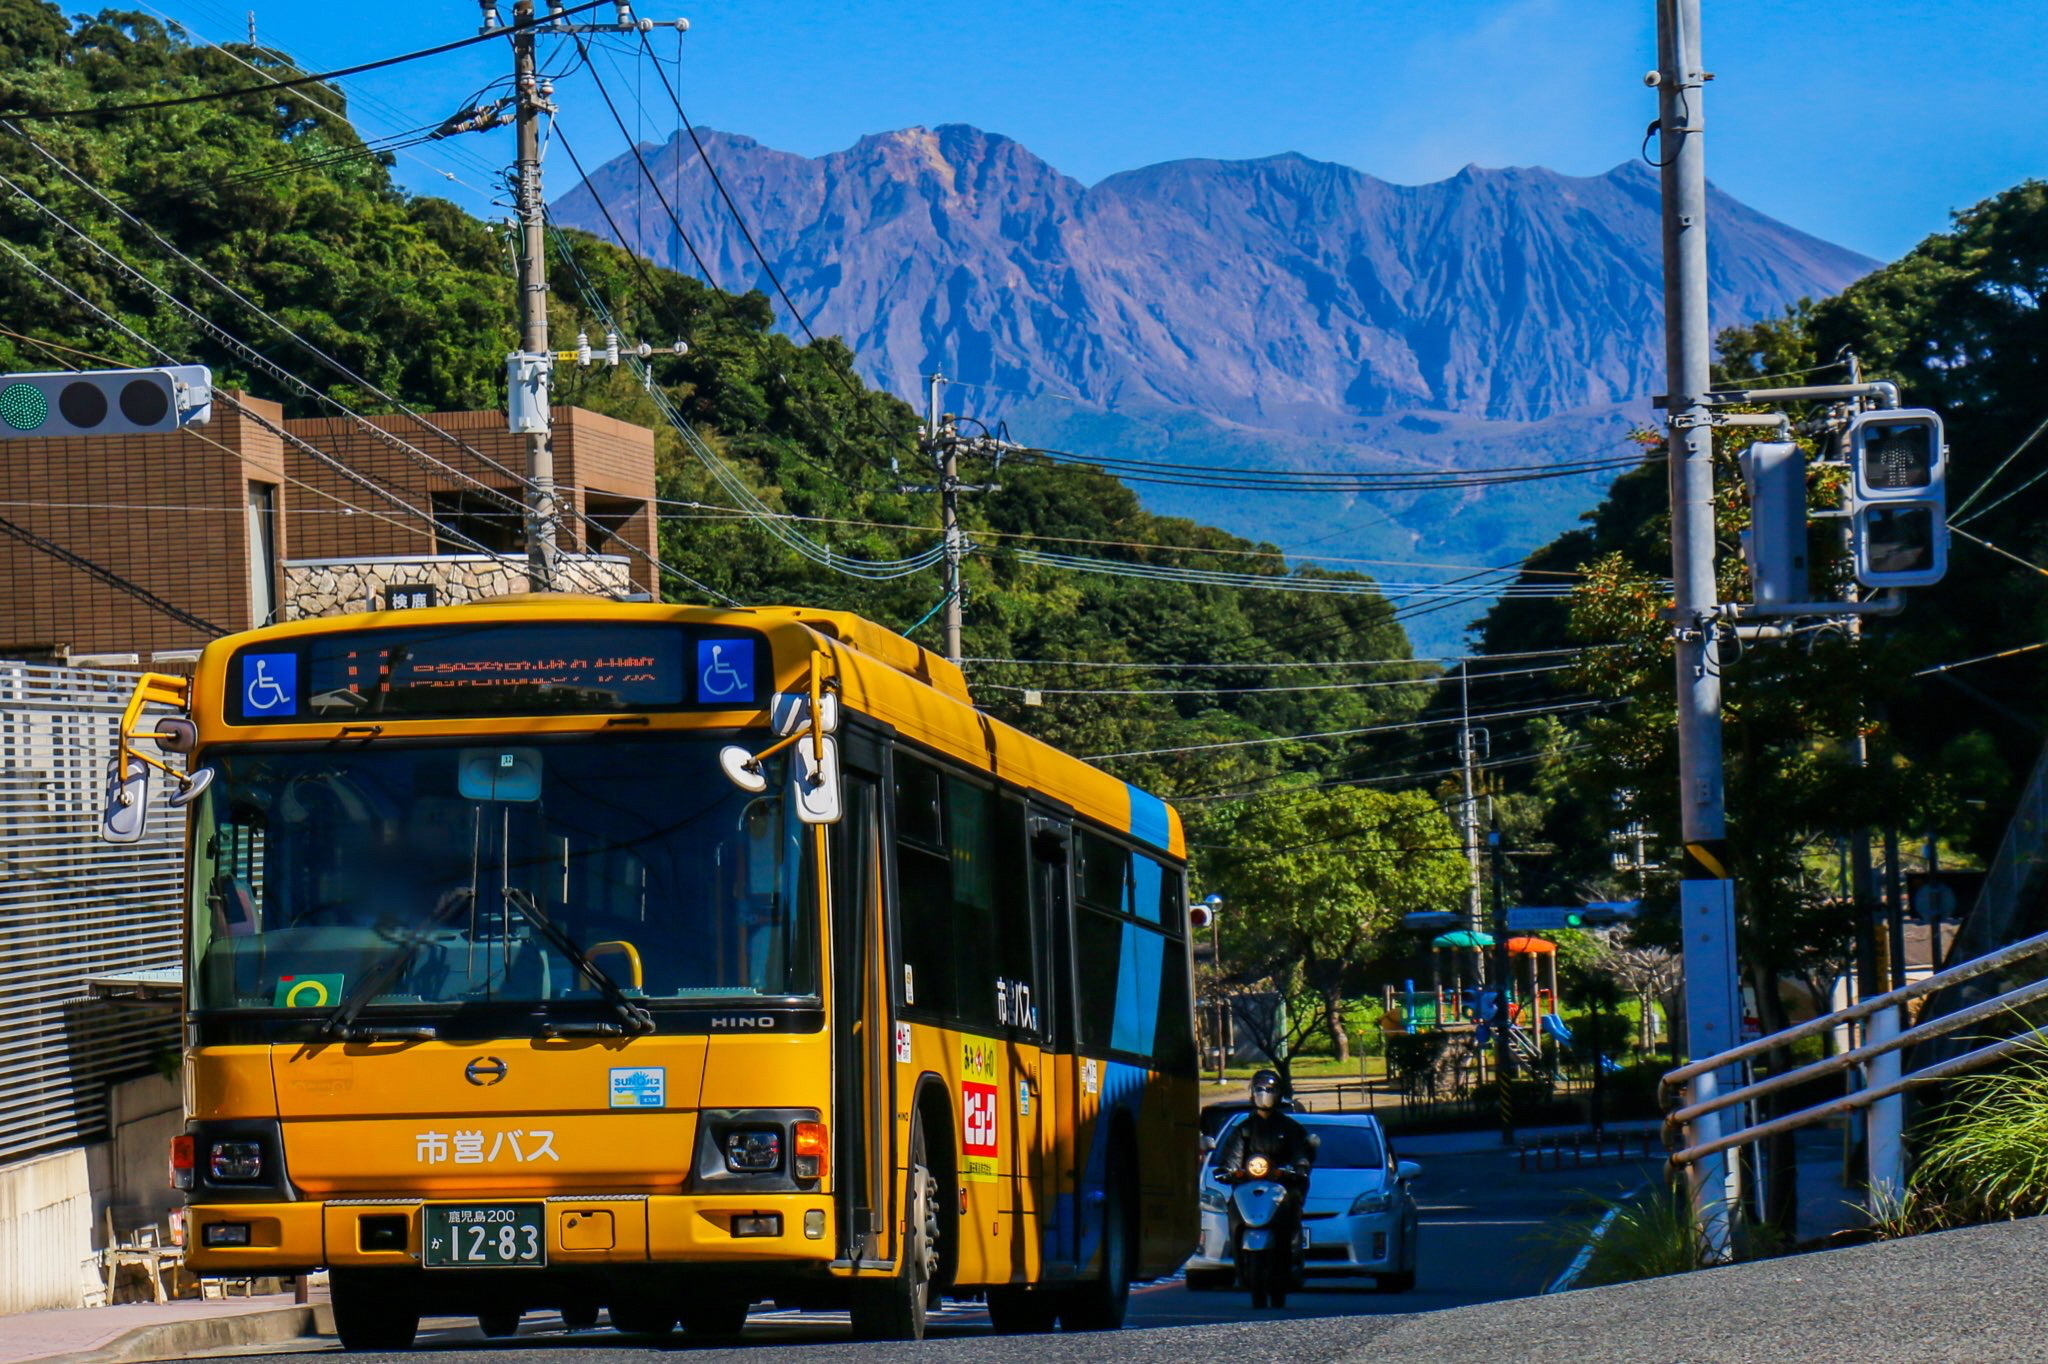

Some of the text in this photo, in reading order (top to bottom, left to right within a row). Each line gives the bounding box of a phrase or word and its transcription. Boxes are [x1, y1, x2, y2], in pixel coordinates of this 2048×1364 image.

[711, 1016, 775, 1028] HINO
[415, 1129, 560, 1165] 市営バス
[431, 1224, 539, 1261] か 12-83
